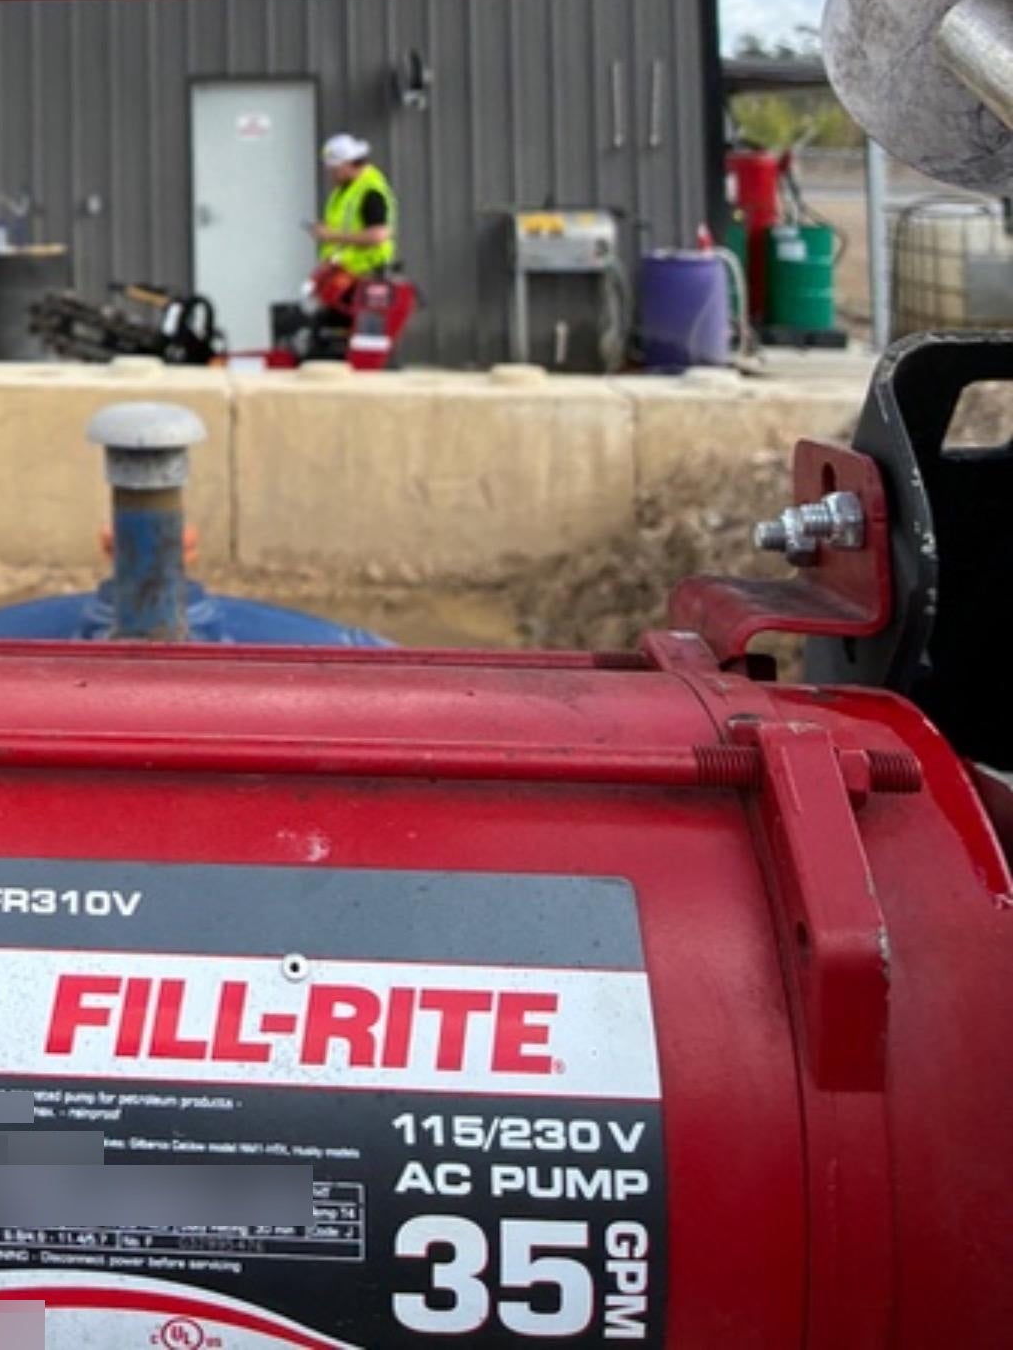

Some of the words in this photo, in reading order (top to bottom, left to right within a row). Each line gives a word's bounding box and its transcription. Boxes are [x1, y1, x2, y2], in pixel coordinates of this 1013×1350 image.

[392, 1113, 602, 1152] 115/230
[608, 1122, 645, 1152] V
[395, 1161, 472, 1195] AC
[491, 1165, 649, 1201] PUMP
[392, 1214, 594, 1336] 35
[604, 1220, 649, 1340] GPM
